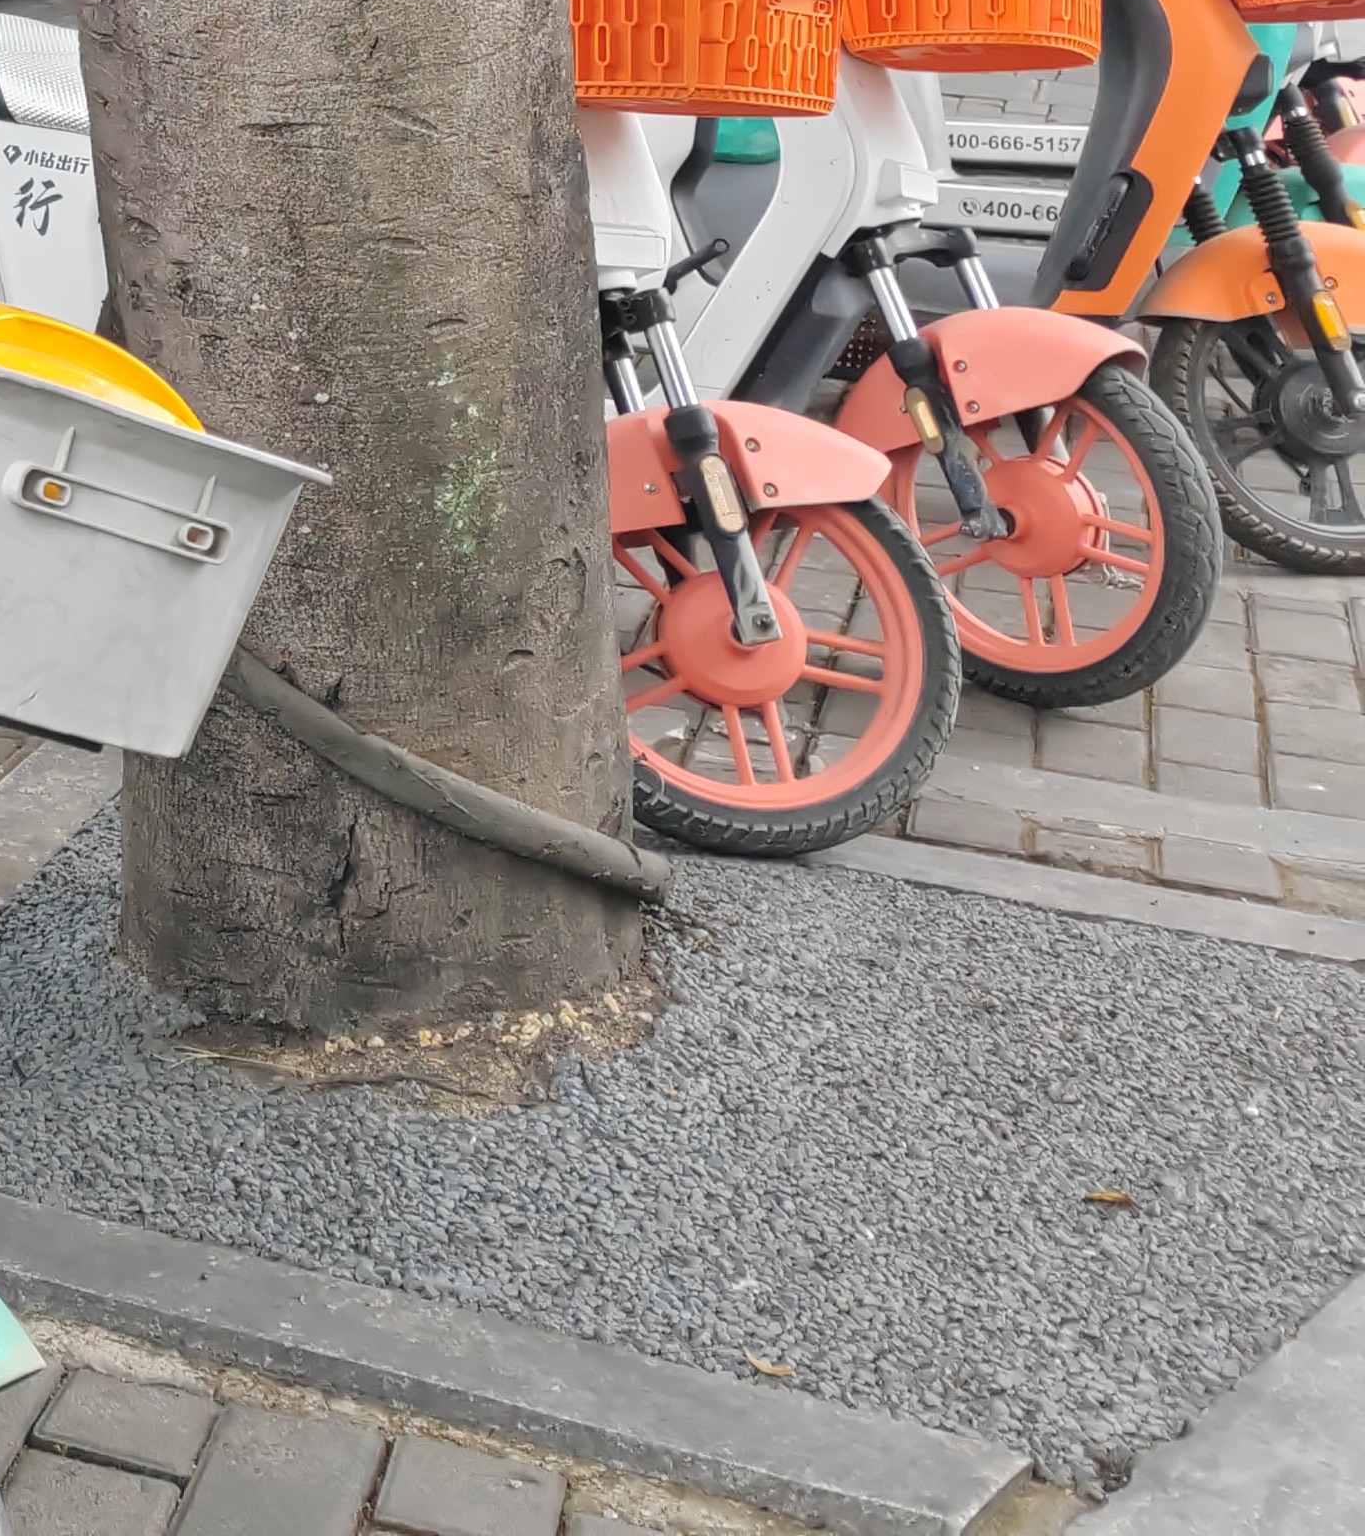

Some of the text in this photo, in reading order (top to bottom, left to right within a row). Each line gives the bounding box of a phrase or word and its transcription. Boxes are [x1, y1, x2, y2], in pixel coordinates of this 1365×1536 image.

[23, 149, 91, 175] 小钻出行
[12, 177, 64, 237] 行
[982, 201, 1061, 222] 400-66
